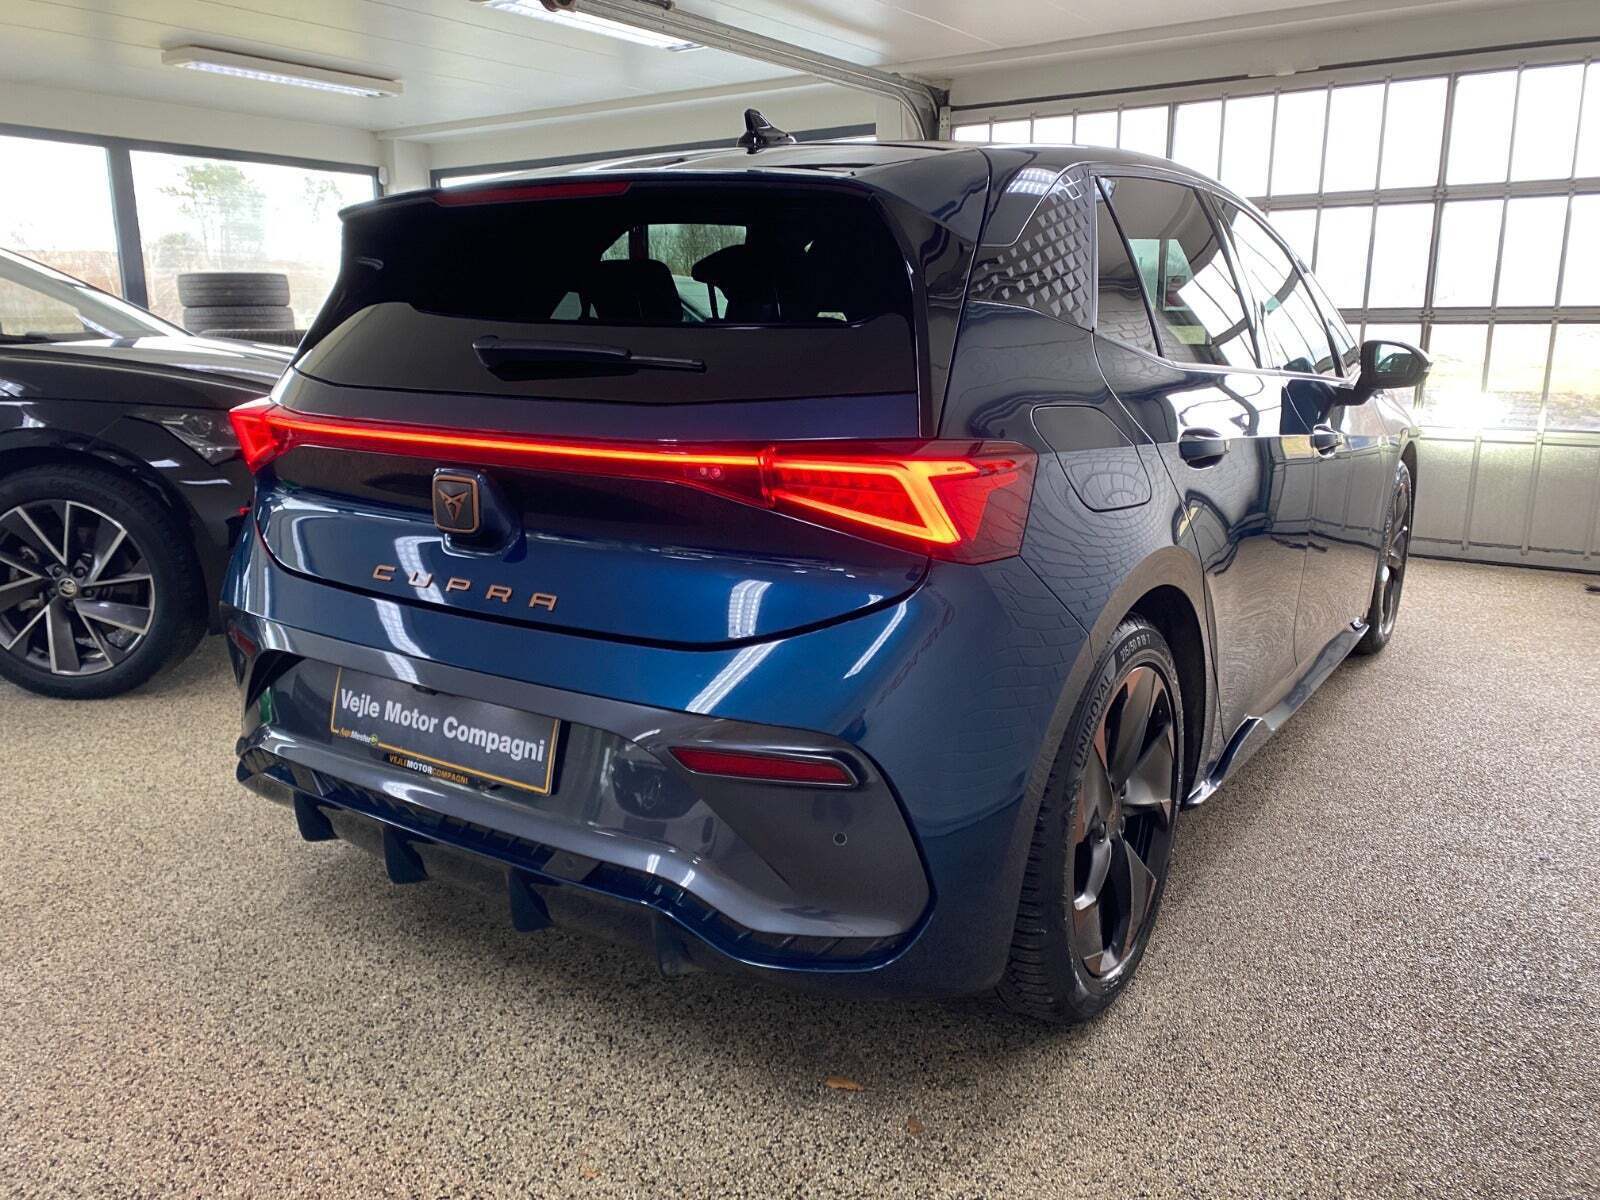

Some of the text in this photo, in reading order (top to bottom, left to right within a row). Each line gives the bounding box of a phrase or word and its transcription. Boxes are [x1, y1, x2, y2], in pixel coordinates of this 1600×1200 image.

[373, 564, 557, 611] CUPRA
[340, 688, 545, 762] Vejle Motor Compagni
[1073, 676, 1113, 767] UNIROYAL
